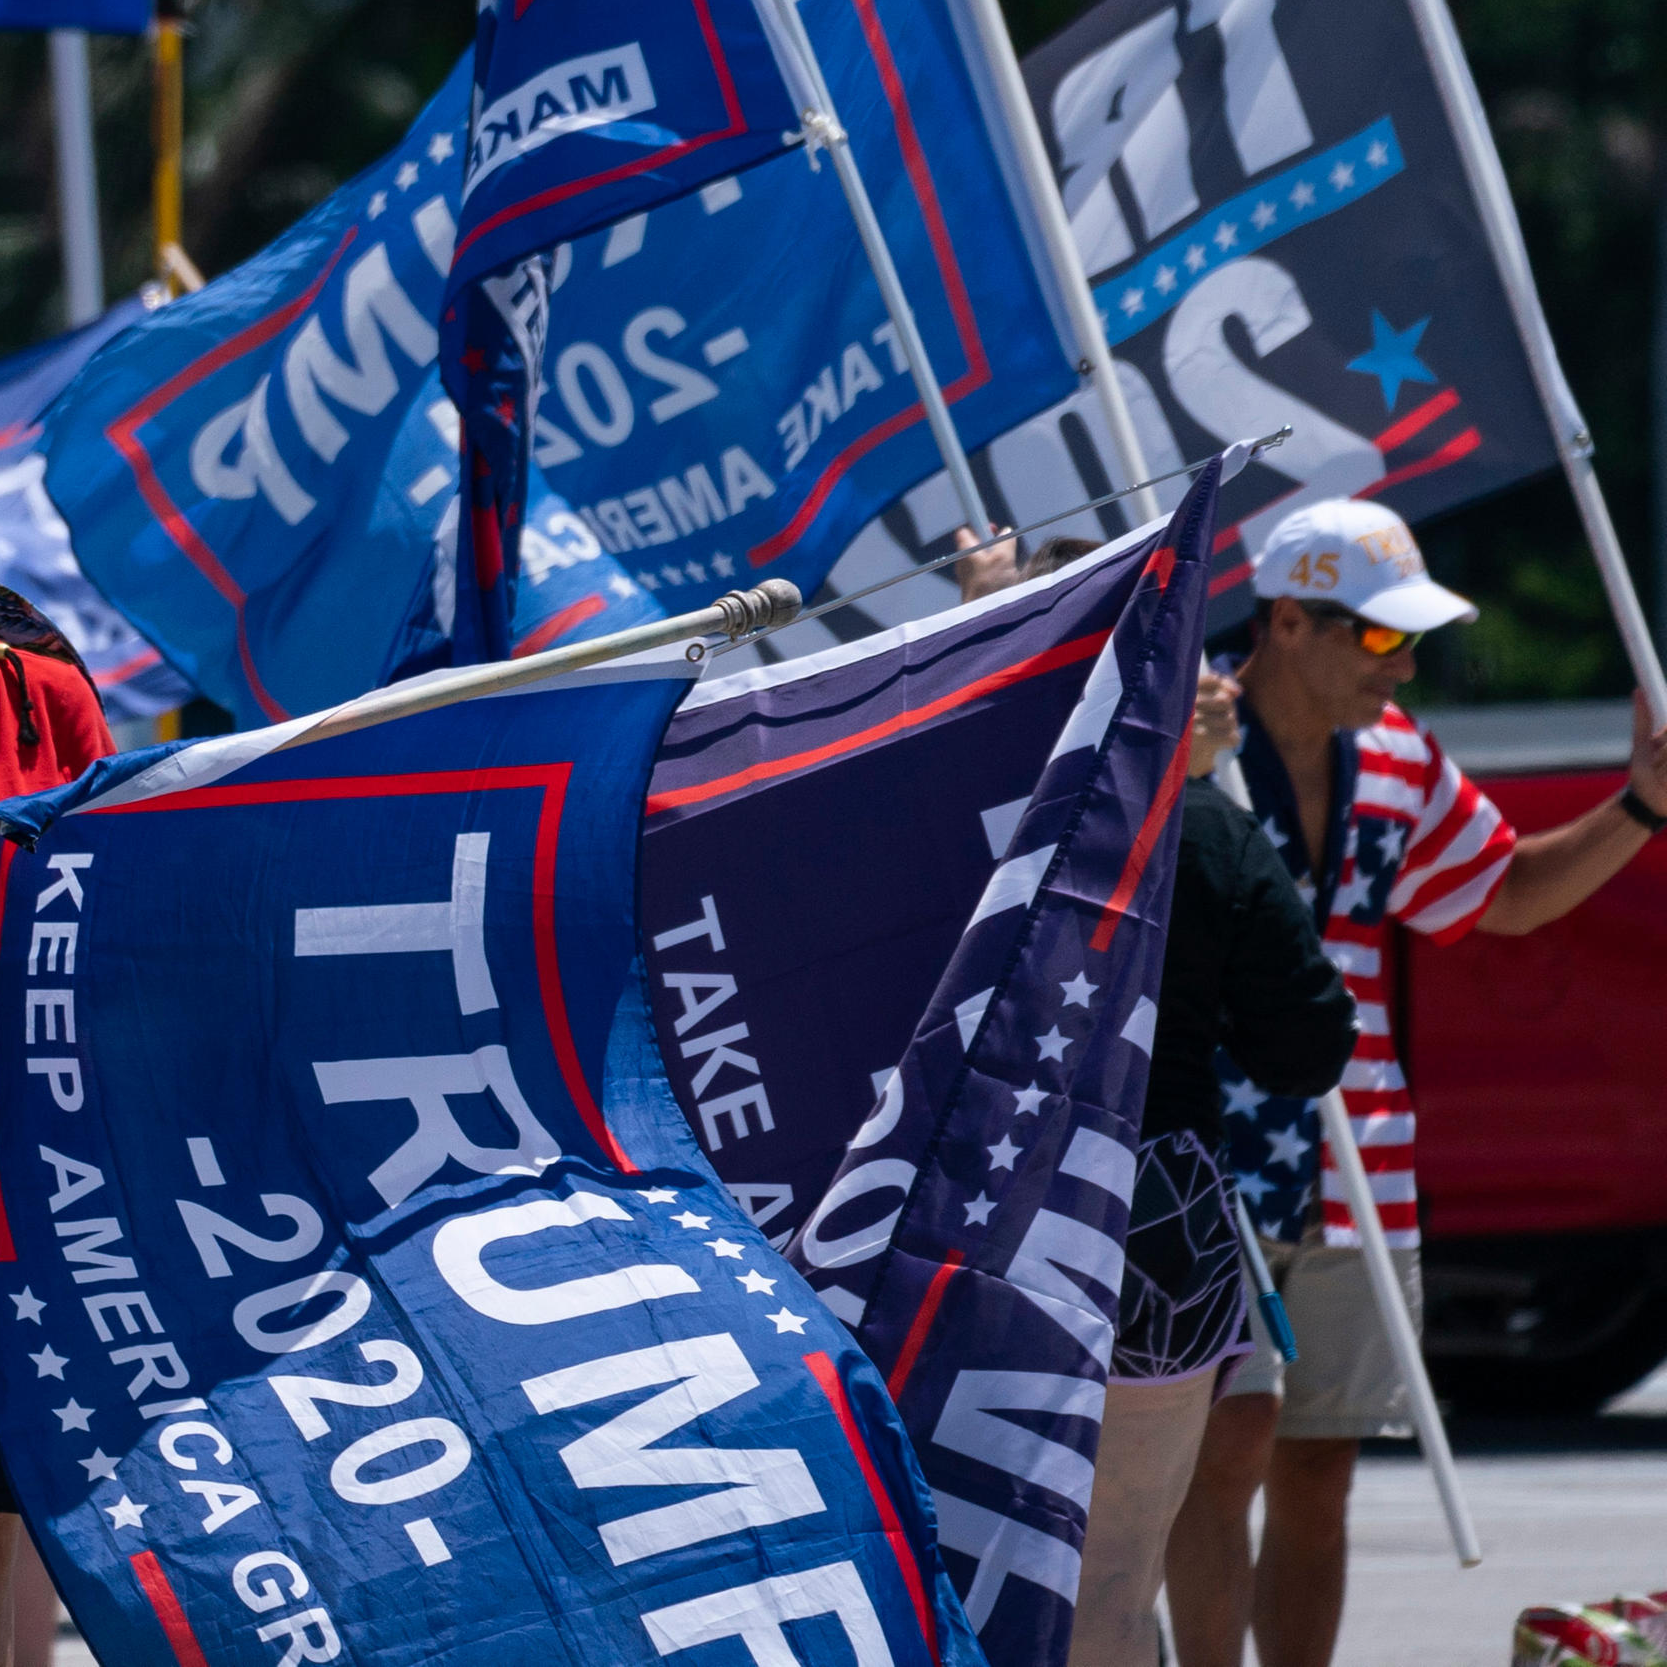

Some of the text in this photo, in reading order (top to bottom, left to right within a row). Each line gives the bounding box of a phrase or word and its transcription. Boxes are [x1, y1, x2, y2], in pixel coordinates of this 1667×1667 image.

[1289, 552, 1341, 591] 45
[24, 852, 94, 1113] KEEP
[652, 895, 774, 1152] TAKE
[39, 1144, 259, 1533] AMERICA
